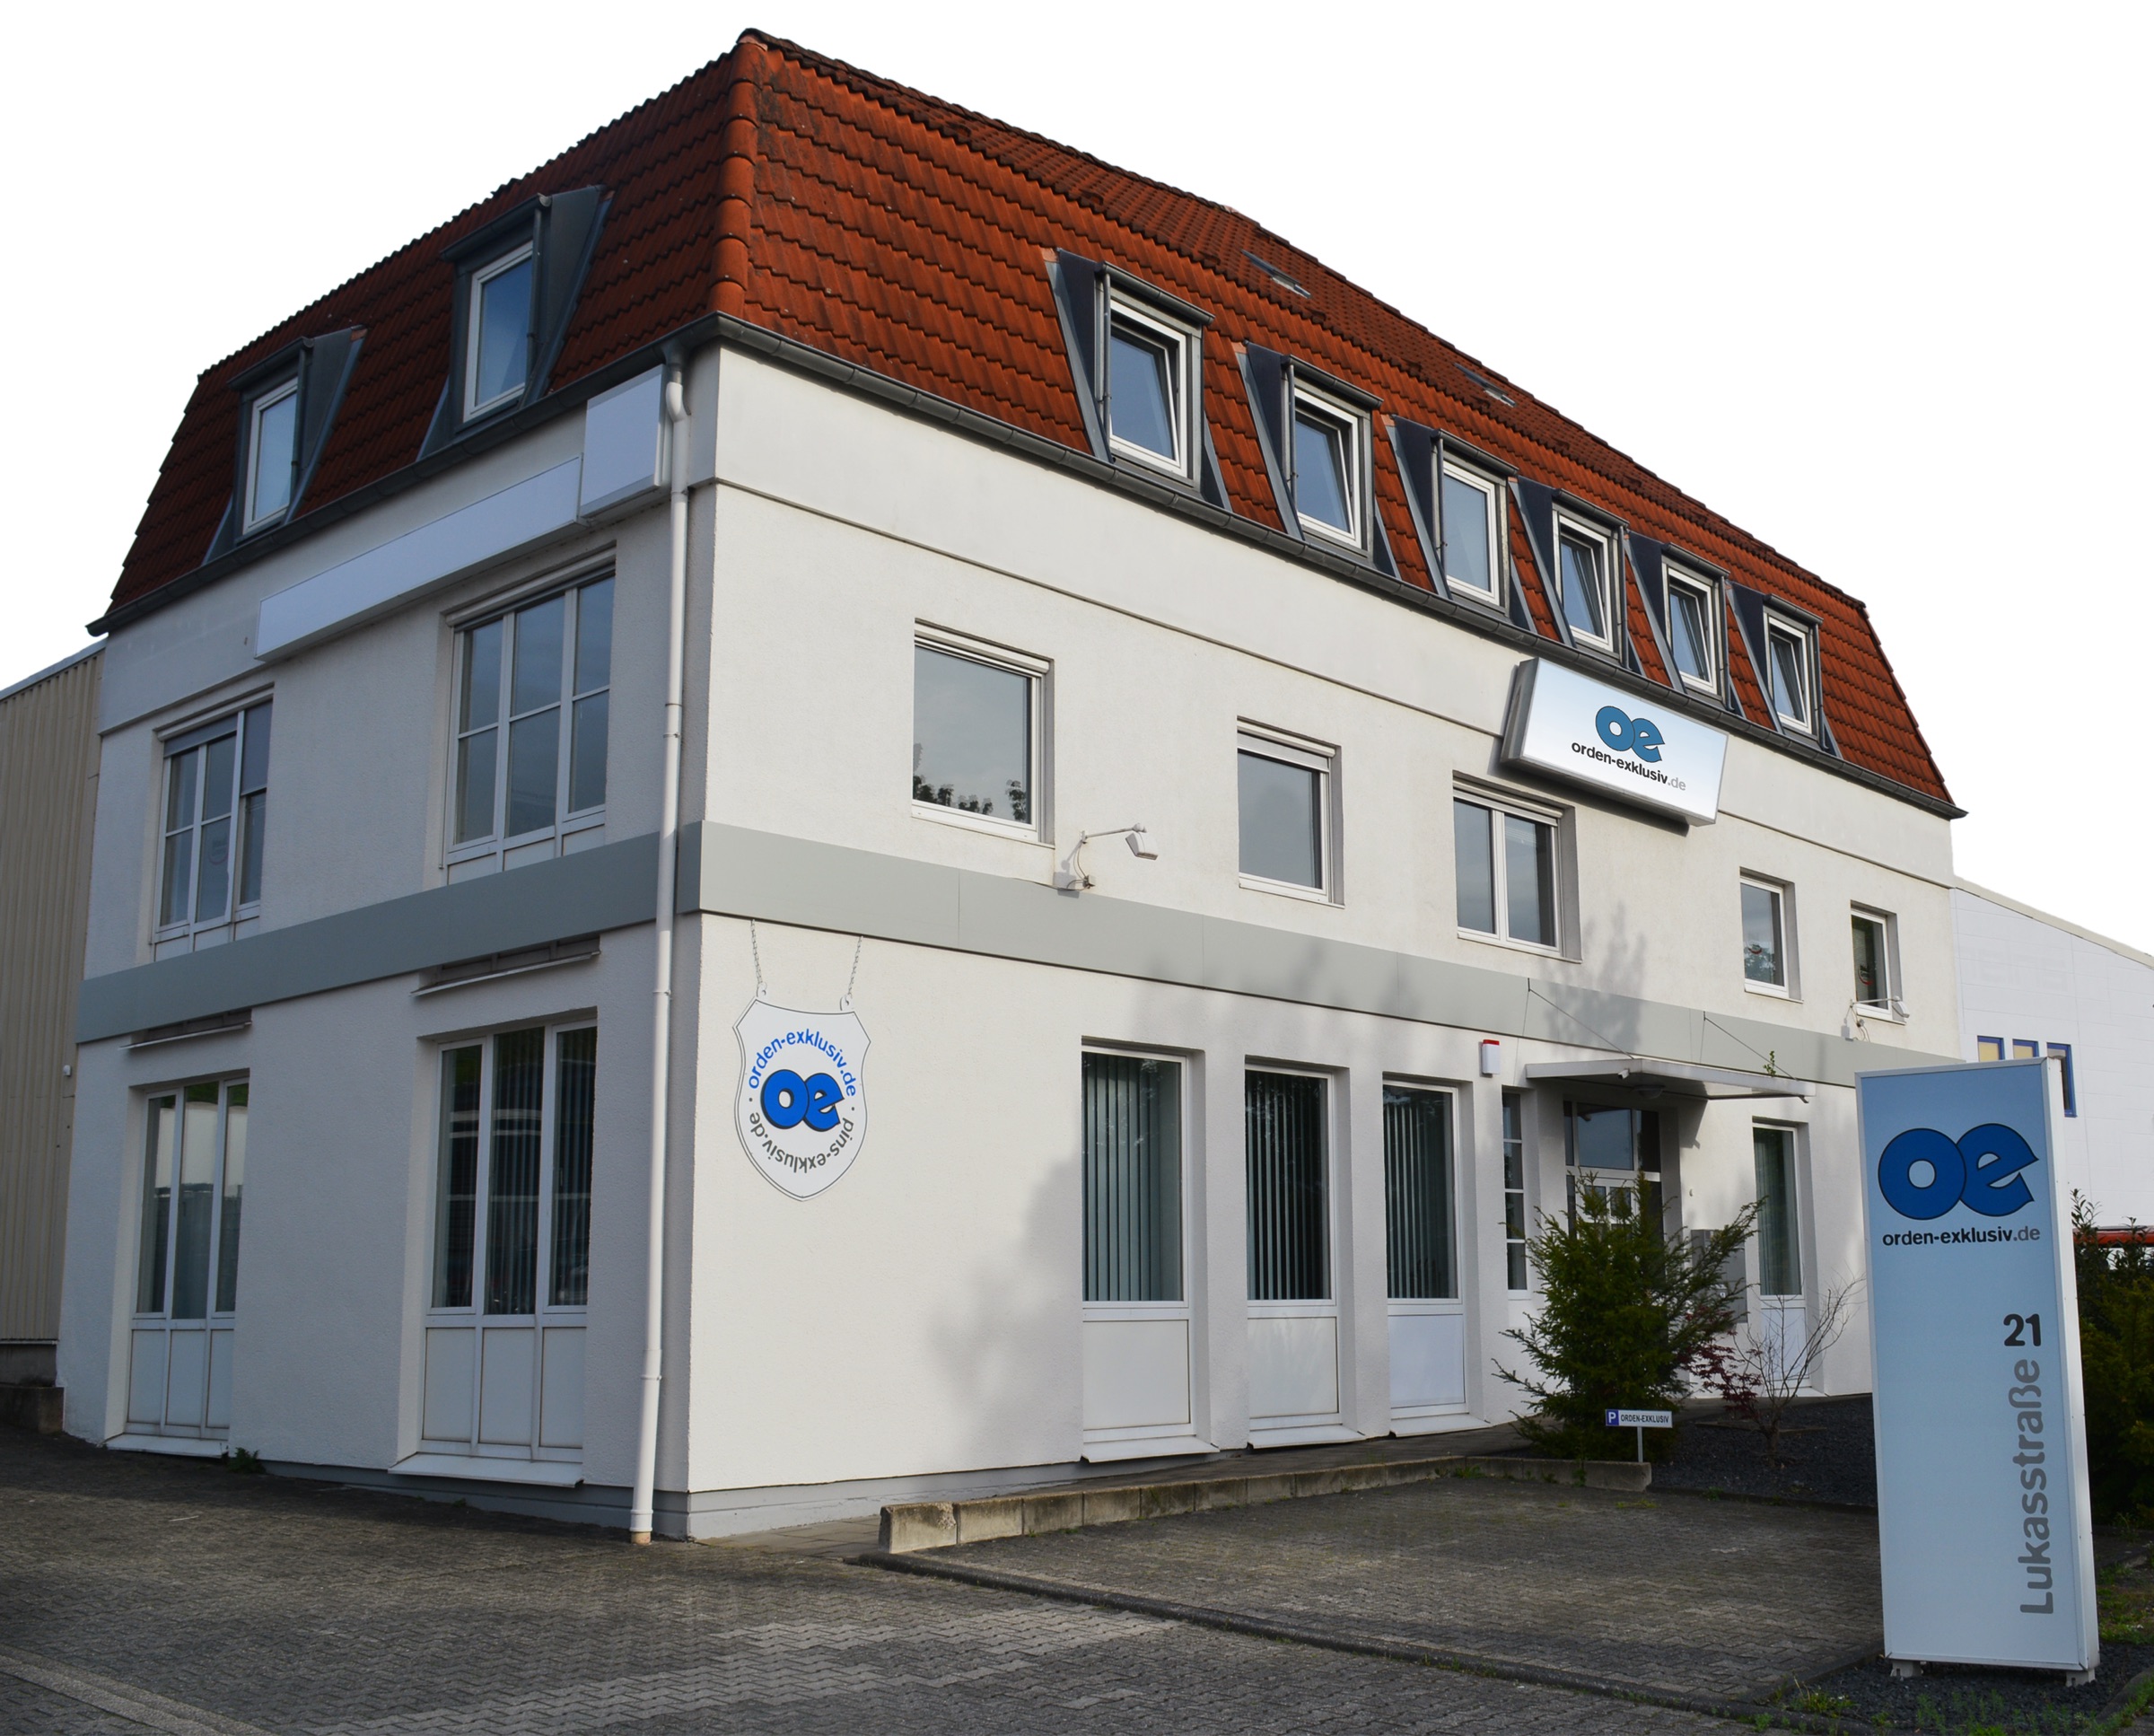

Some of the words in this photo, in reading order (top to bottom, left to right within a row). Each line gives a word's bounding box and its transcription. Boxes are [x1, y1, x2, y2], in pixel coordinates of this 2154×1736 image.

[1595, 706, 1666, 763] oe
[1572, 741, 1686, 791] orden-exklusiv.de
[749, 1028, 856, 1096] orden-exklusiv.de
[760, 1068, 845, 1132] oe
[749, 1111, 854, 1173] pins-exklusiv.de
[1878, 1122, 2039, 1220] oe
[1882, 1226, 2040, 1247] orden-exklusiv.de
[2003, 1312, 2041, 1347] 21
[1608, 1411, 1616, 1424] P
[1620, 1414, 1669, 1424] ORDEN-EXKLUSIV
[2008, 1358, 2053, 1615] Lukasstraße
